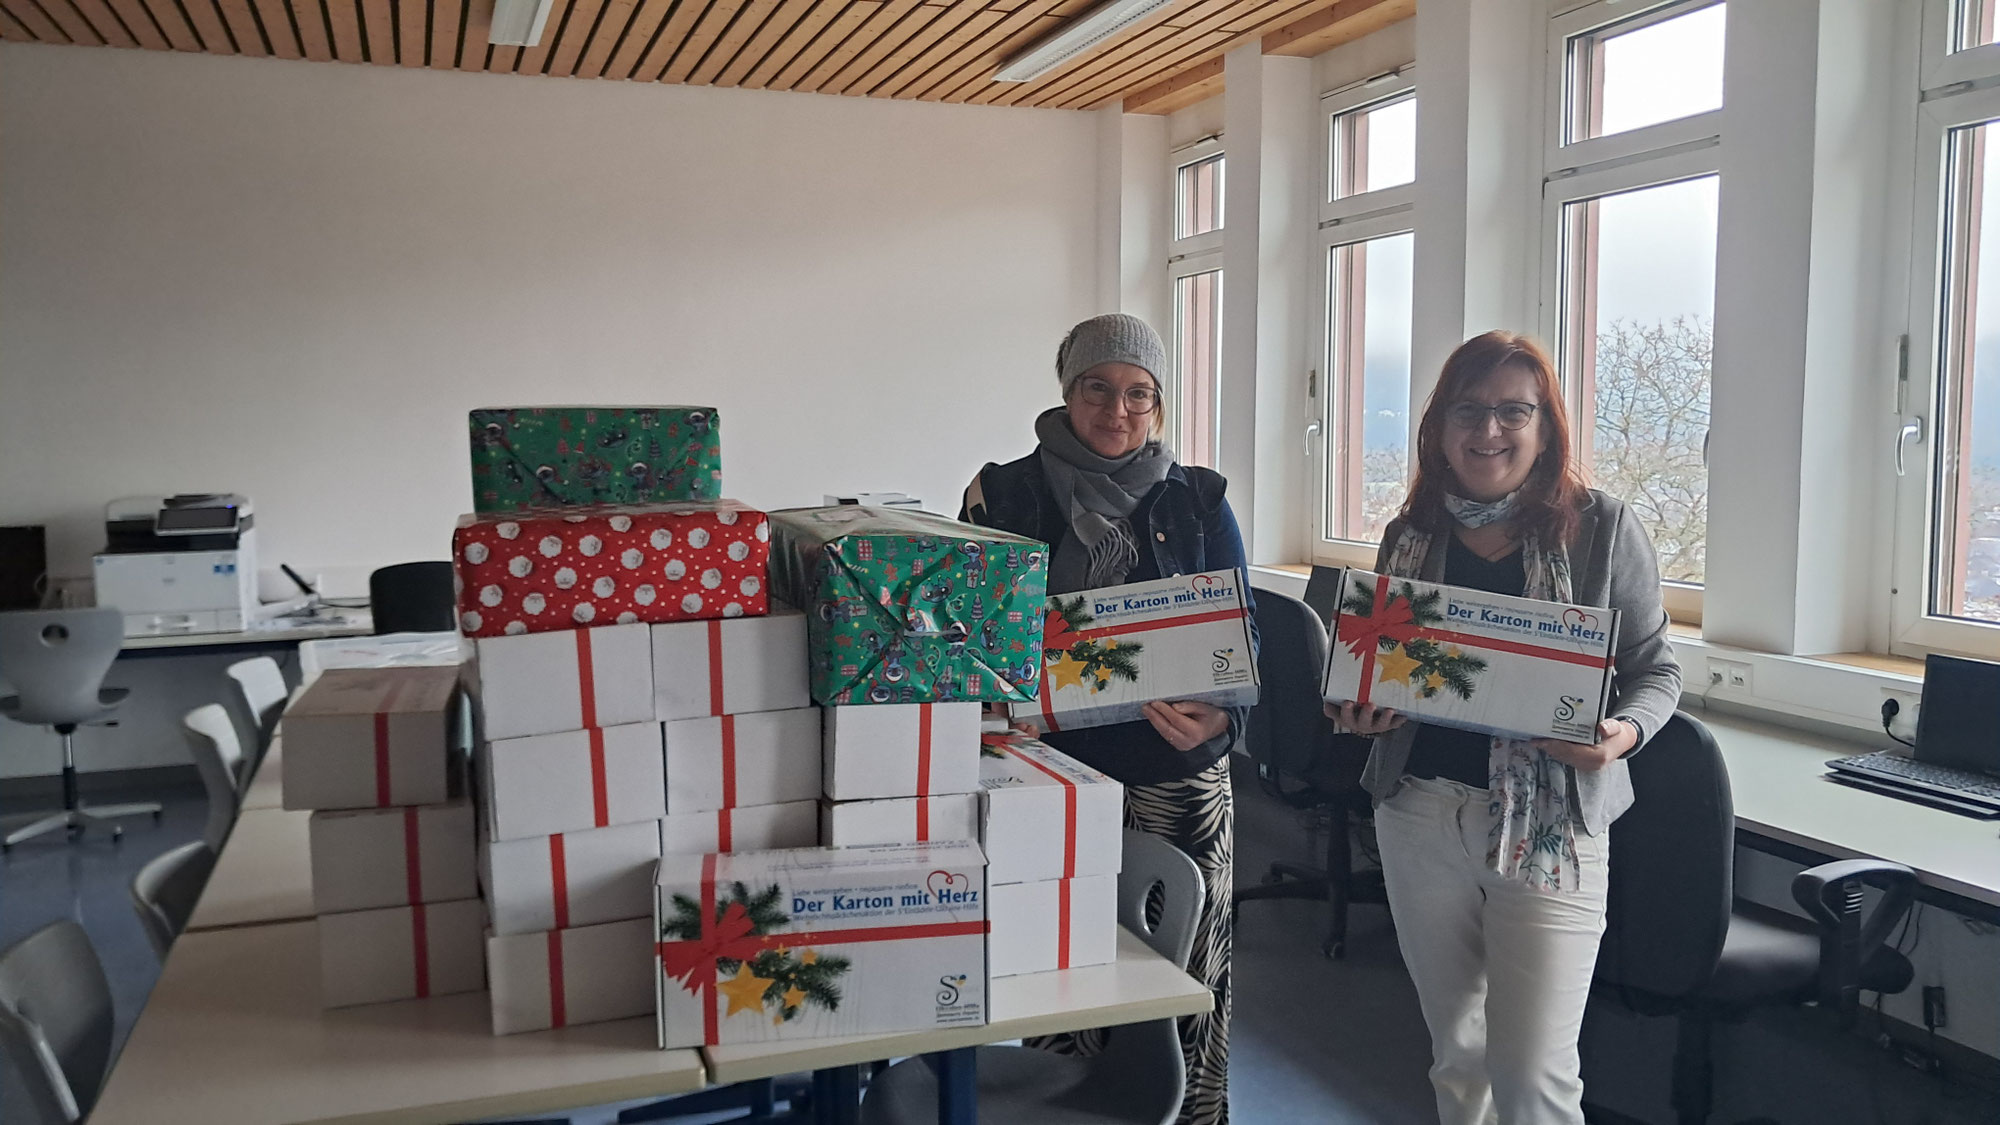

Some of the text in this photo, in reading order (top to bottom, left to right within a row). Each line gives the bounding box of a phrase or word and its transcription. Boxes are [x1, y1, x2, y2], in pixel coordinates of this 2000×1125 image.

[1095, 602, 1119, 615] Der
[1124, 596, 1169, 611] Karton
[1174, 590, 1196, 604] mit
[1202, 587, 1233, 599] Herz
[1447, 603, 1474, 619] Der
[1480, 609, 1532, 629] Karton
[1538, 620, 1565, 634] mit
[1570, 624, 1606, 642] Herz
[793, 889, 978, 914] Der Karton mit Herz
